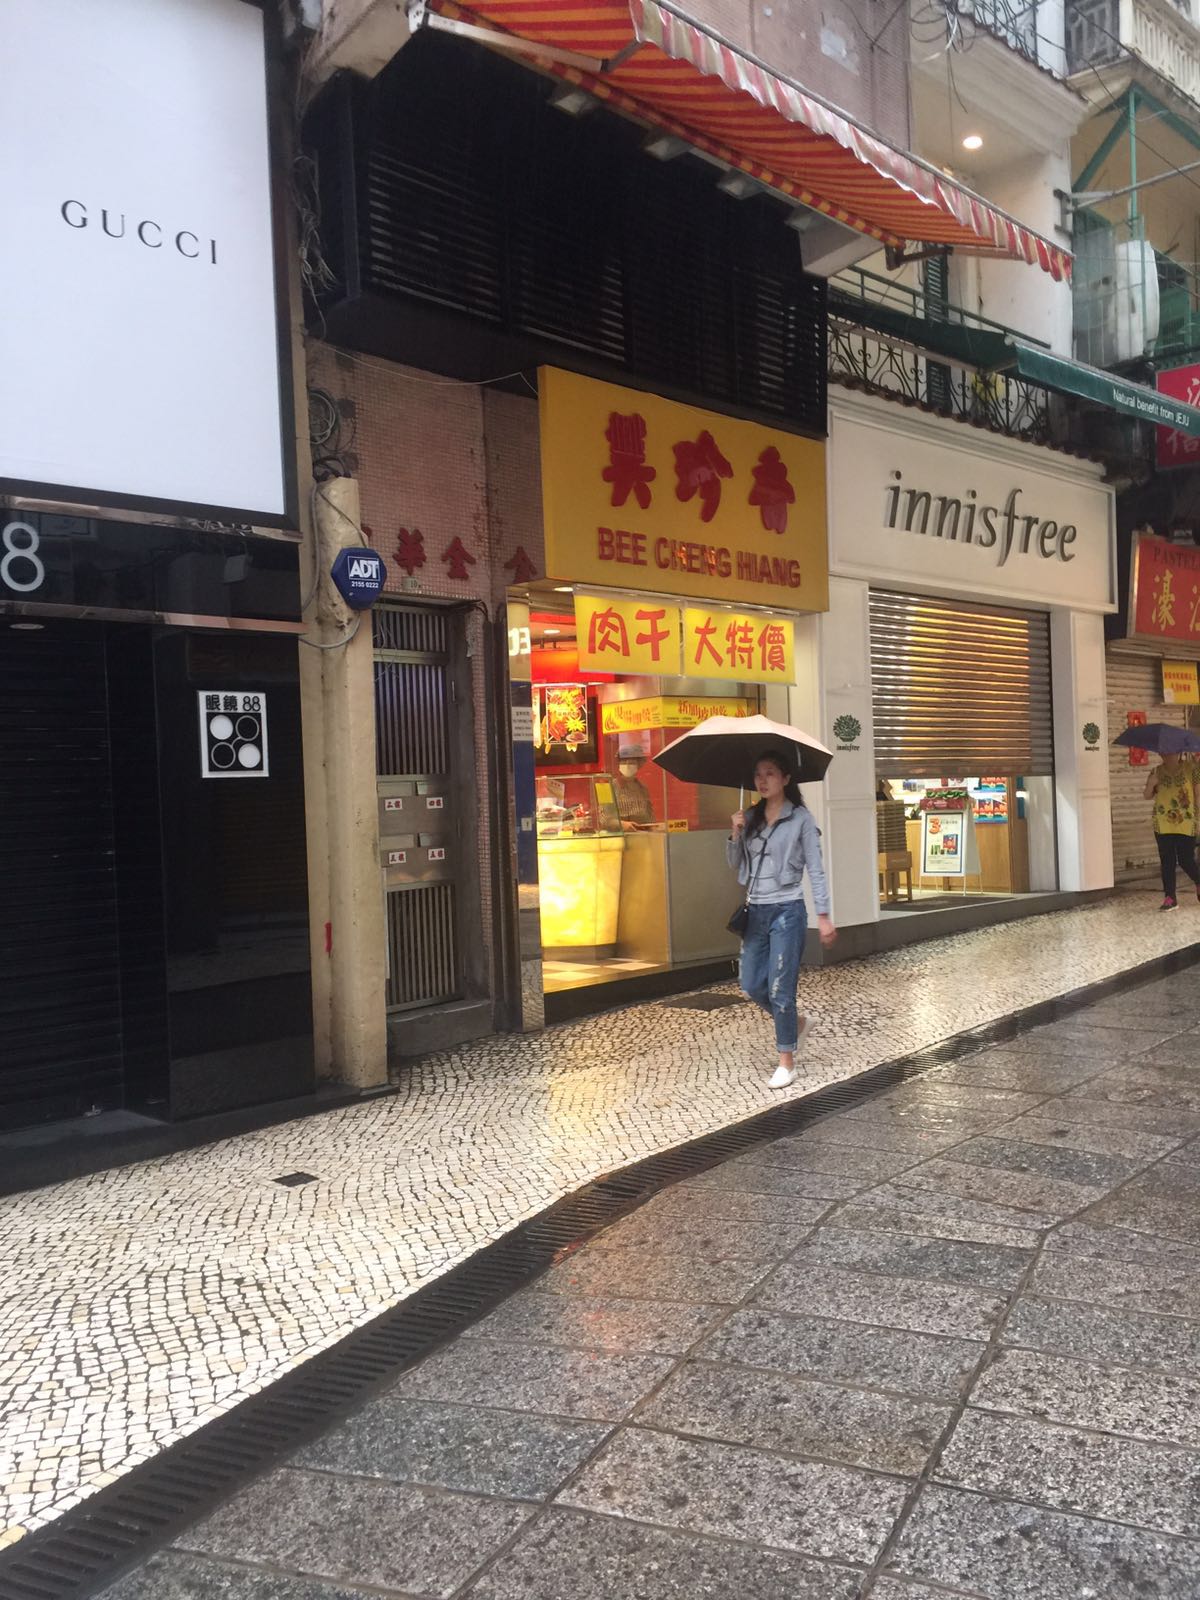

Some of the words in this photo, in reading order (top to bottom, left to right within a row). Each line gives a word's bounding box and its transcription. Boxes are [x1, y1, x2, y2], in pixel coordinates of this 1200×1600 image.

[61, 199, 217, 265] GUCCI
[1113, 386, 1136, 408] Natural
[1136, 396, 1159, 416] benefit
[1160, 405, 1174, 420] from
[1175, 412, 1190, 427] JEJU
[884, 470, 1077, 567] innisfree
[350, 557, 379, 579] ADT
[351, 580, 365, 588] 2155
[365, 581, 379, 589] 0222
[597, 527, 648, 566] BEE
[654, 537, 732, 578] CHENG
[736, 551, 801, 588] HIANG
[588, 606, 670, 662] 肉干
[694, 616, 786, 672] 大特價
